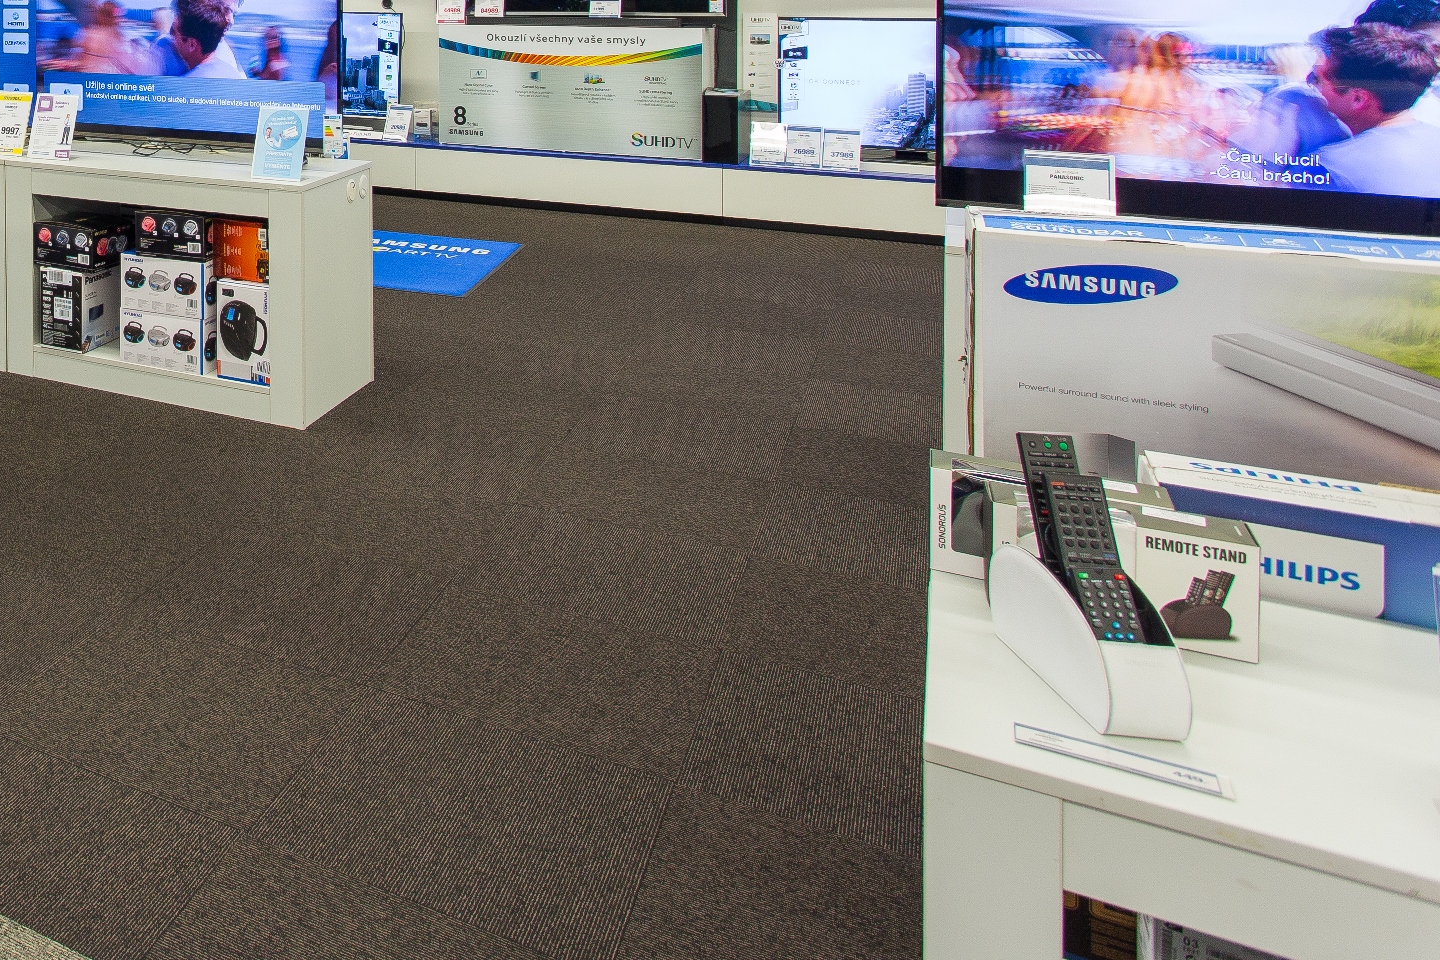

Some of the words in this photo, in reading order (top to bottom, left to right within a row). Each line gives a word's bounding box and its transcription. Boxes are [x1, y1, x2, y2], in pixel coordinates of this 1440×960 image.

[486, 31, 528, 45] Okouzlí
[530, 32, 578, 47] všechny
[581, 34, 605, 45] vaše
[608, 35, 646, 48] smysly
[85, 80, 105, 90] Užijte
[106, 81, 114, 90] si
[114, 82, 137, 91] online
[138, 83, 155, 92] svět
[453, 105, 467, 126] 8
[449, 128, 484, 137] SAMSUNG
[1220, 147, 1267, 166] -Čau,
[1273, 152, 1320, 167] kluci!
[1209, 164, 1257, 182] -Čau,
[1262, 168, 1331, 185] brácho!
[1011, 224, 1147, 238] SOUNDBAR
[1024, 270, 1157, 299] SAMSUNG
[1018, 381, 1056, 393] Powerful
[1058, 387, 1098, 399] surround
[1100, 392, 1129, 403] sound
[1130, 397, 1150, 406] with
[1152, 399, 1177, 409] sleek
[1179, 402, 1210, 414] styling
[1189, 461, 1362, 493] PHILIPS
[938, 503, 947, 549] SONOROUS
[1145, 535, 1200, 558] REMOTE
[1202, 545, 1247, 564] STAND
[1259, 556, 1361, 591] HILIPS
